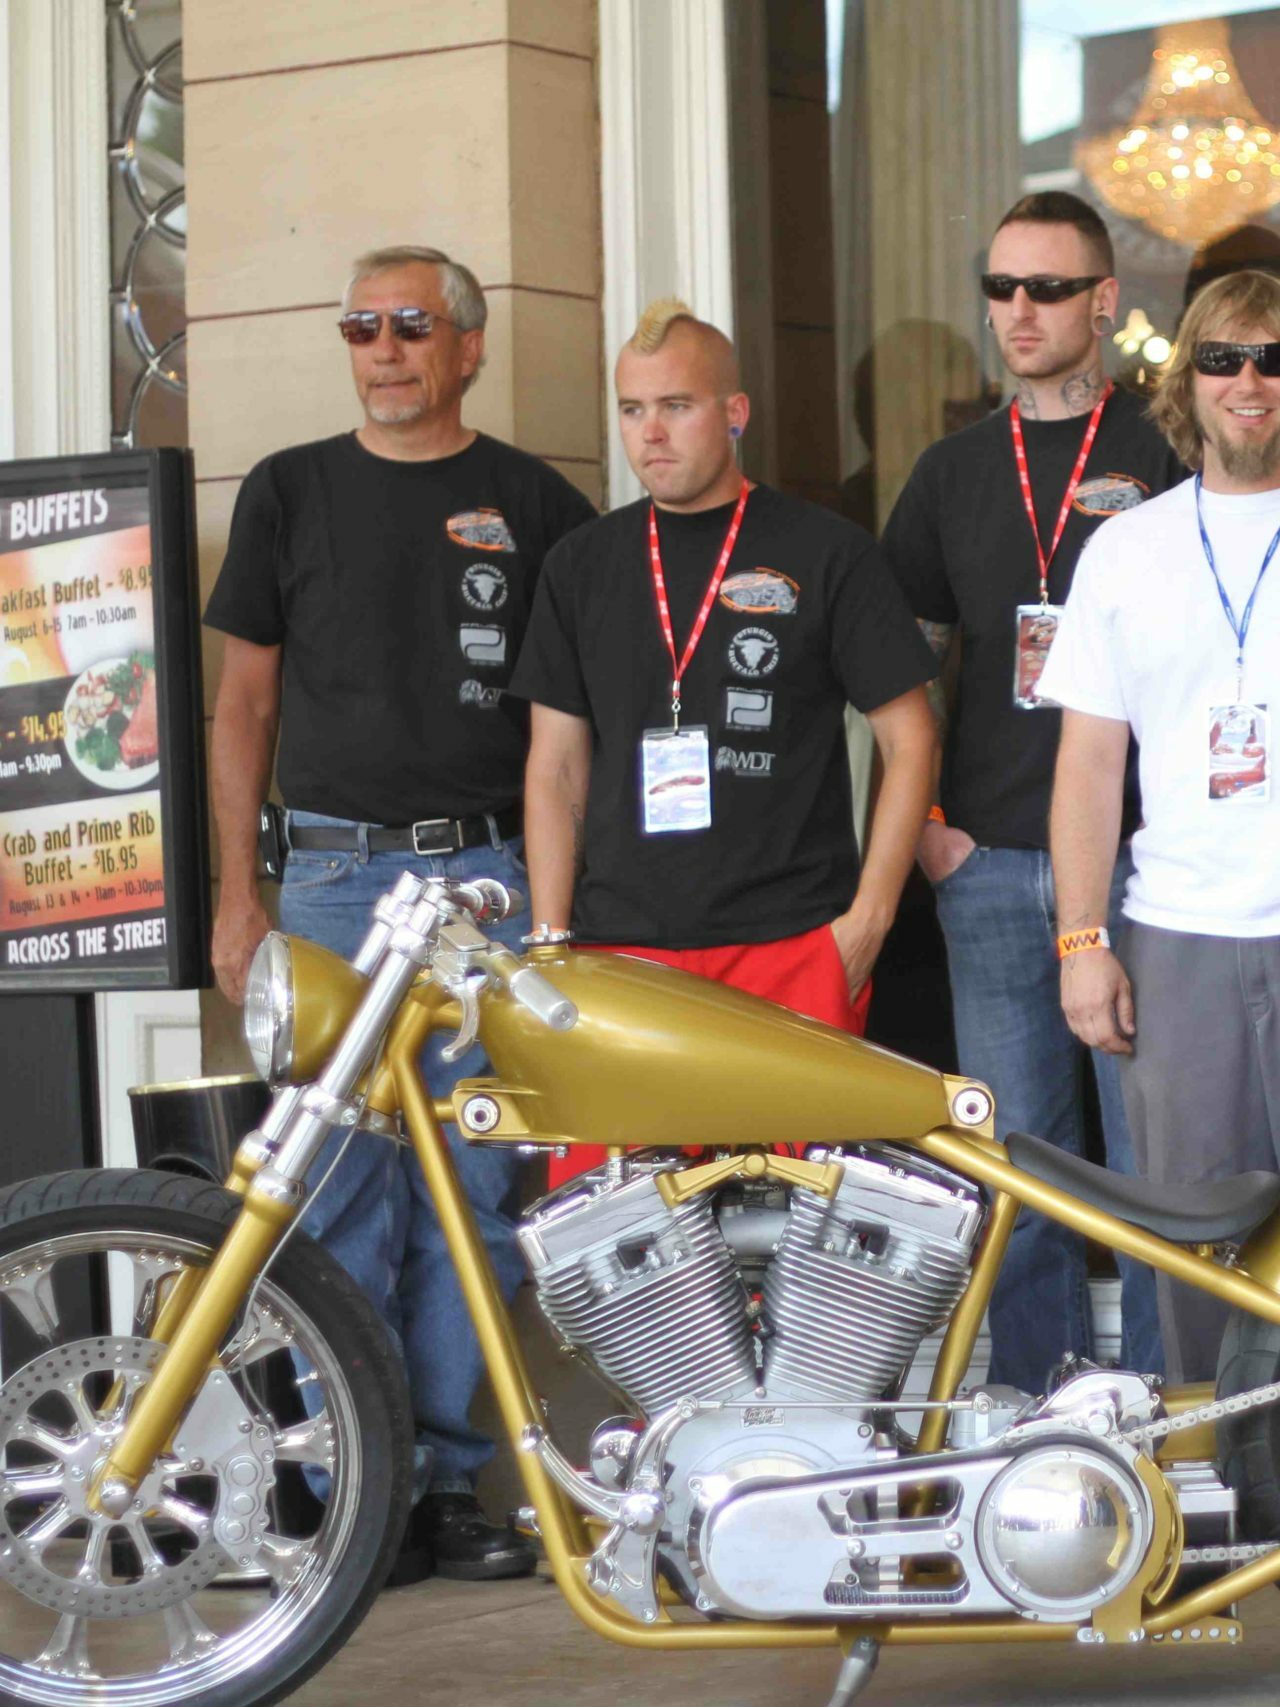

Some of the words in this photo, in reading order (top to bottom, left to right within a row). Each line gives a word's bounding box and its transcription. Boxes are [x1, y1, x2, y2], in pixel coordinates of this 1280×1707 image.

[10, 488, 109, 541] BUFFETS
[53, 574, 101, 605] Buffet
[4, 622, 37, 644] August
[22, 710, 67, 744] $14.95
[734, 751, 776, 771] WDT
[3, 829, 37, 857] Crab
[44, 822, 71, 851] and
[77, 818, 122, 847] Prime
[129, 810, 156, 838] Rib
[24, 855, 73, 886] Buffet
[95, 845, 138, 874] $16.95
[7, 932, 70, 964] ACROSS
[76, 926, 107, 957] THE
